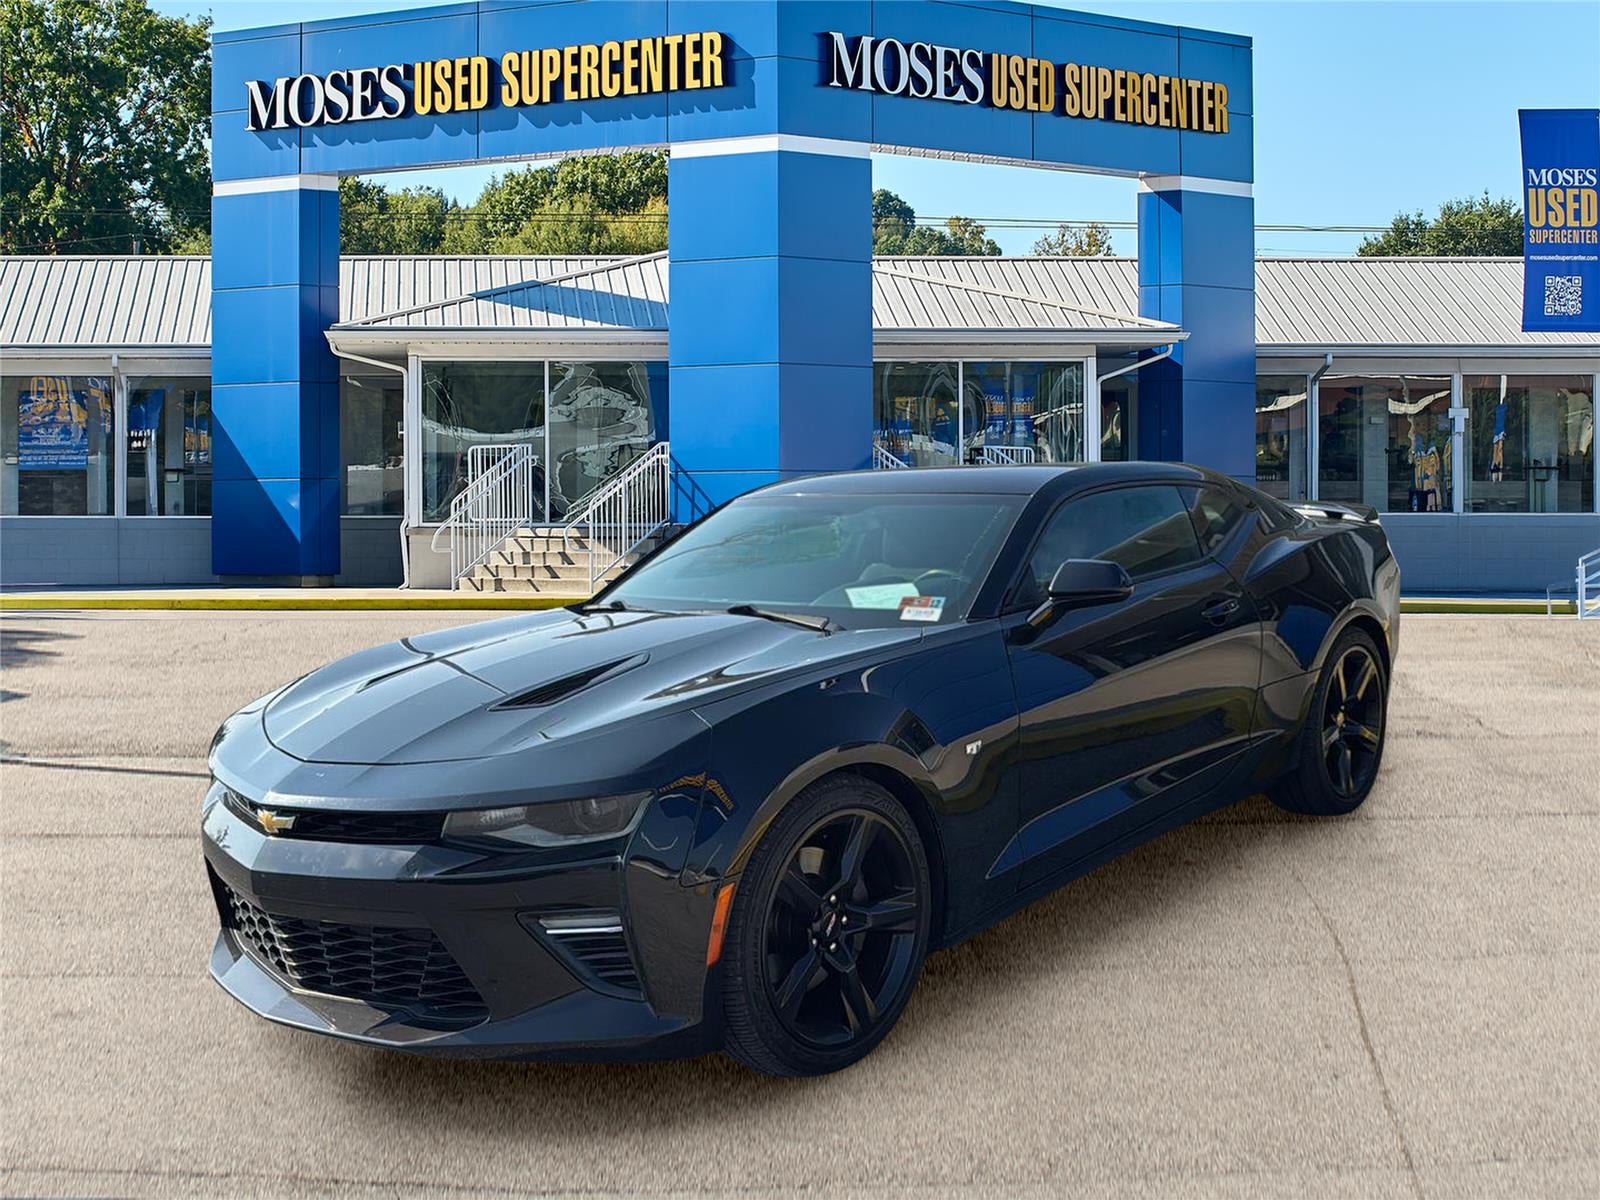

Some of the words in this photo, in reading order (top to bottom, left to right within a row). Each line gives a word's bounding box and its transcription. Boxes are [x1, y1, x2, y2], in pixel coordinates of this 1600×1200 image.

[245, 63, 409, 132] MOSES
[413, 55, 490, 116] USED
[500, 31, 724, 108] SUPERCENTER
[828, 31, 986, 105] MOSES
[990, 52, 1056, 113] USED
[1064, 62, 1230, 134] SUPERCENTER
[1528, 168, 1597, 186] MOSES
[1528, 188, 1598, 228] USED
[1529, 230, 1598, 244] SUPERCENTER
